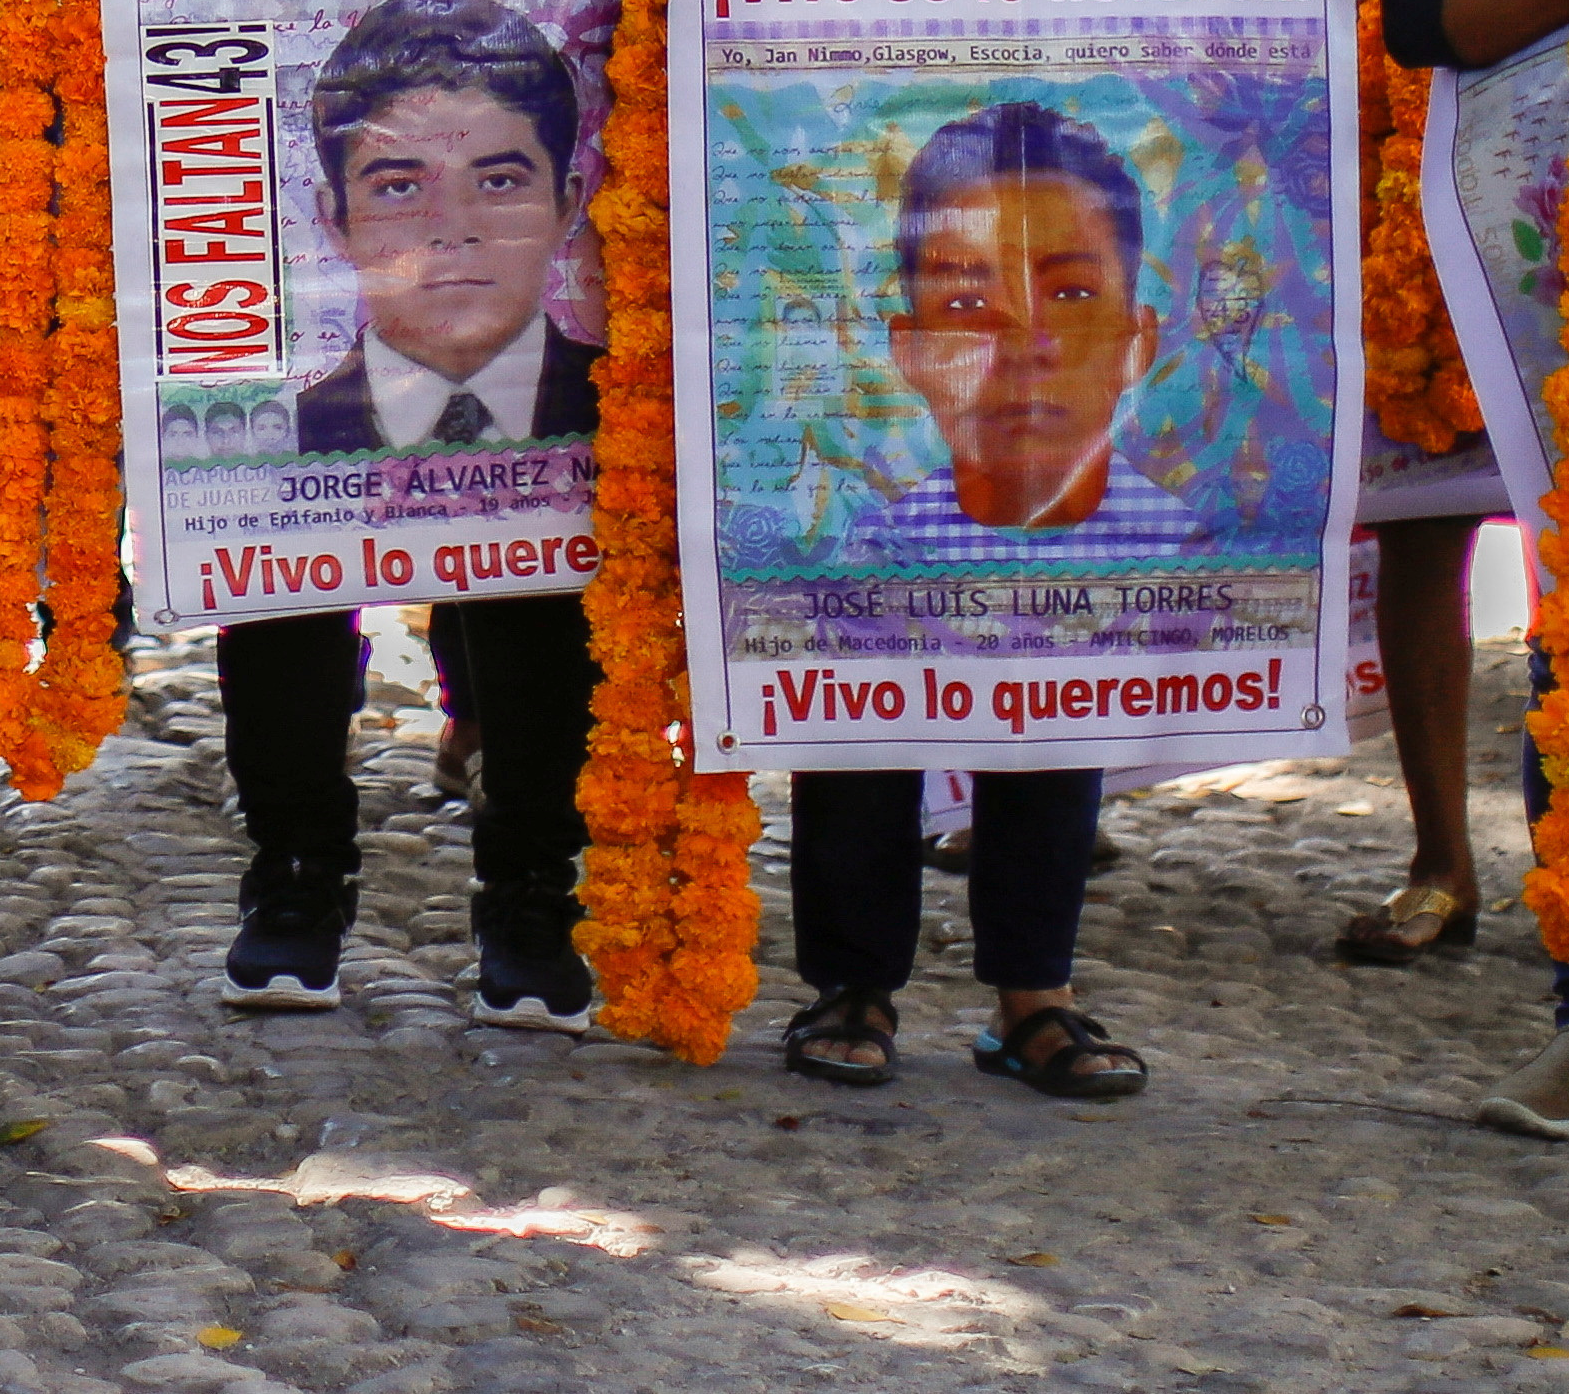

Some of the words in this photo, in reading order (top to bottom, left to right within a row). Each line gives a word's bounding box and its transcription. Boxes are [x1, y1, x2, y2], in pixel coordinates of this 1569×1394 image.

[145, 23, 269, 94] 43!
[722, 47, 752, 66] Yo,
[766, 47, 797, 64] Jan
[970, 43, 1050, 63] Escocia,
[1065, 43, 1129, 62] quiero
[1141, 41, 1194, 60] saber
[1205, 41, 1257, 59] dónde
[1268, 41, 1310, 59] está
[160, 97, 266, 265] FALTAN
[166, 280, 269, 374] NOS
[280, 472, 383, 502] JORGE
[405, 458, 549, 497] ÁLVAREZ
[185, 514, 229, 533] Hijo
[238, 513, 259, 528] de
[269, 508, 354, 530] Epifanio
[364, 510, 376, 526] y
[479, 498, 499, 514] 19
[510, 493, 551, 511] años
[200, 542, 343, 611] ¡Vivo
[363, 538, 413, 587] lo
[804, 583, 882, 620] JOSÉ
[907, 582, 988, 617] LUÍS
[1013, 588, 1093, 617] LUNA
[1116, 585, 1233, 613] TORRES
[745, 636, 792, 655] Hijo
[804, 636, 827, 653] de
[838, 633, 941, 652] Macedonia
[977, 633, 999, 650] 20
[1011, 633, 1054, 651] años
[1212, 624, 1289, 644] MORELOS
[763, 668, 905, 736] ¡Vivo
[925, 667, 974, 719] lo
[992, 660, 1282, 734] queremos!
